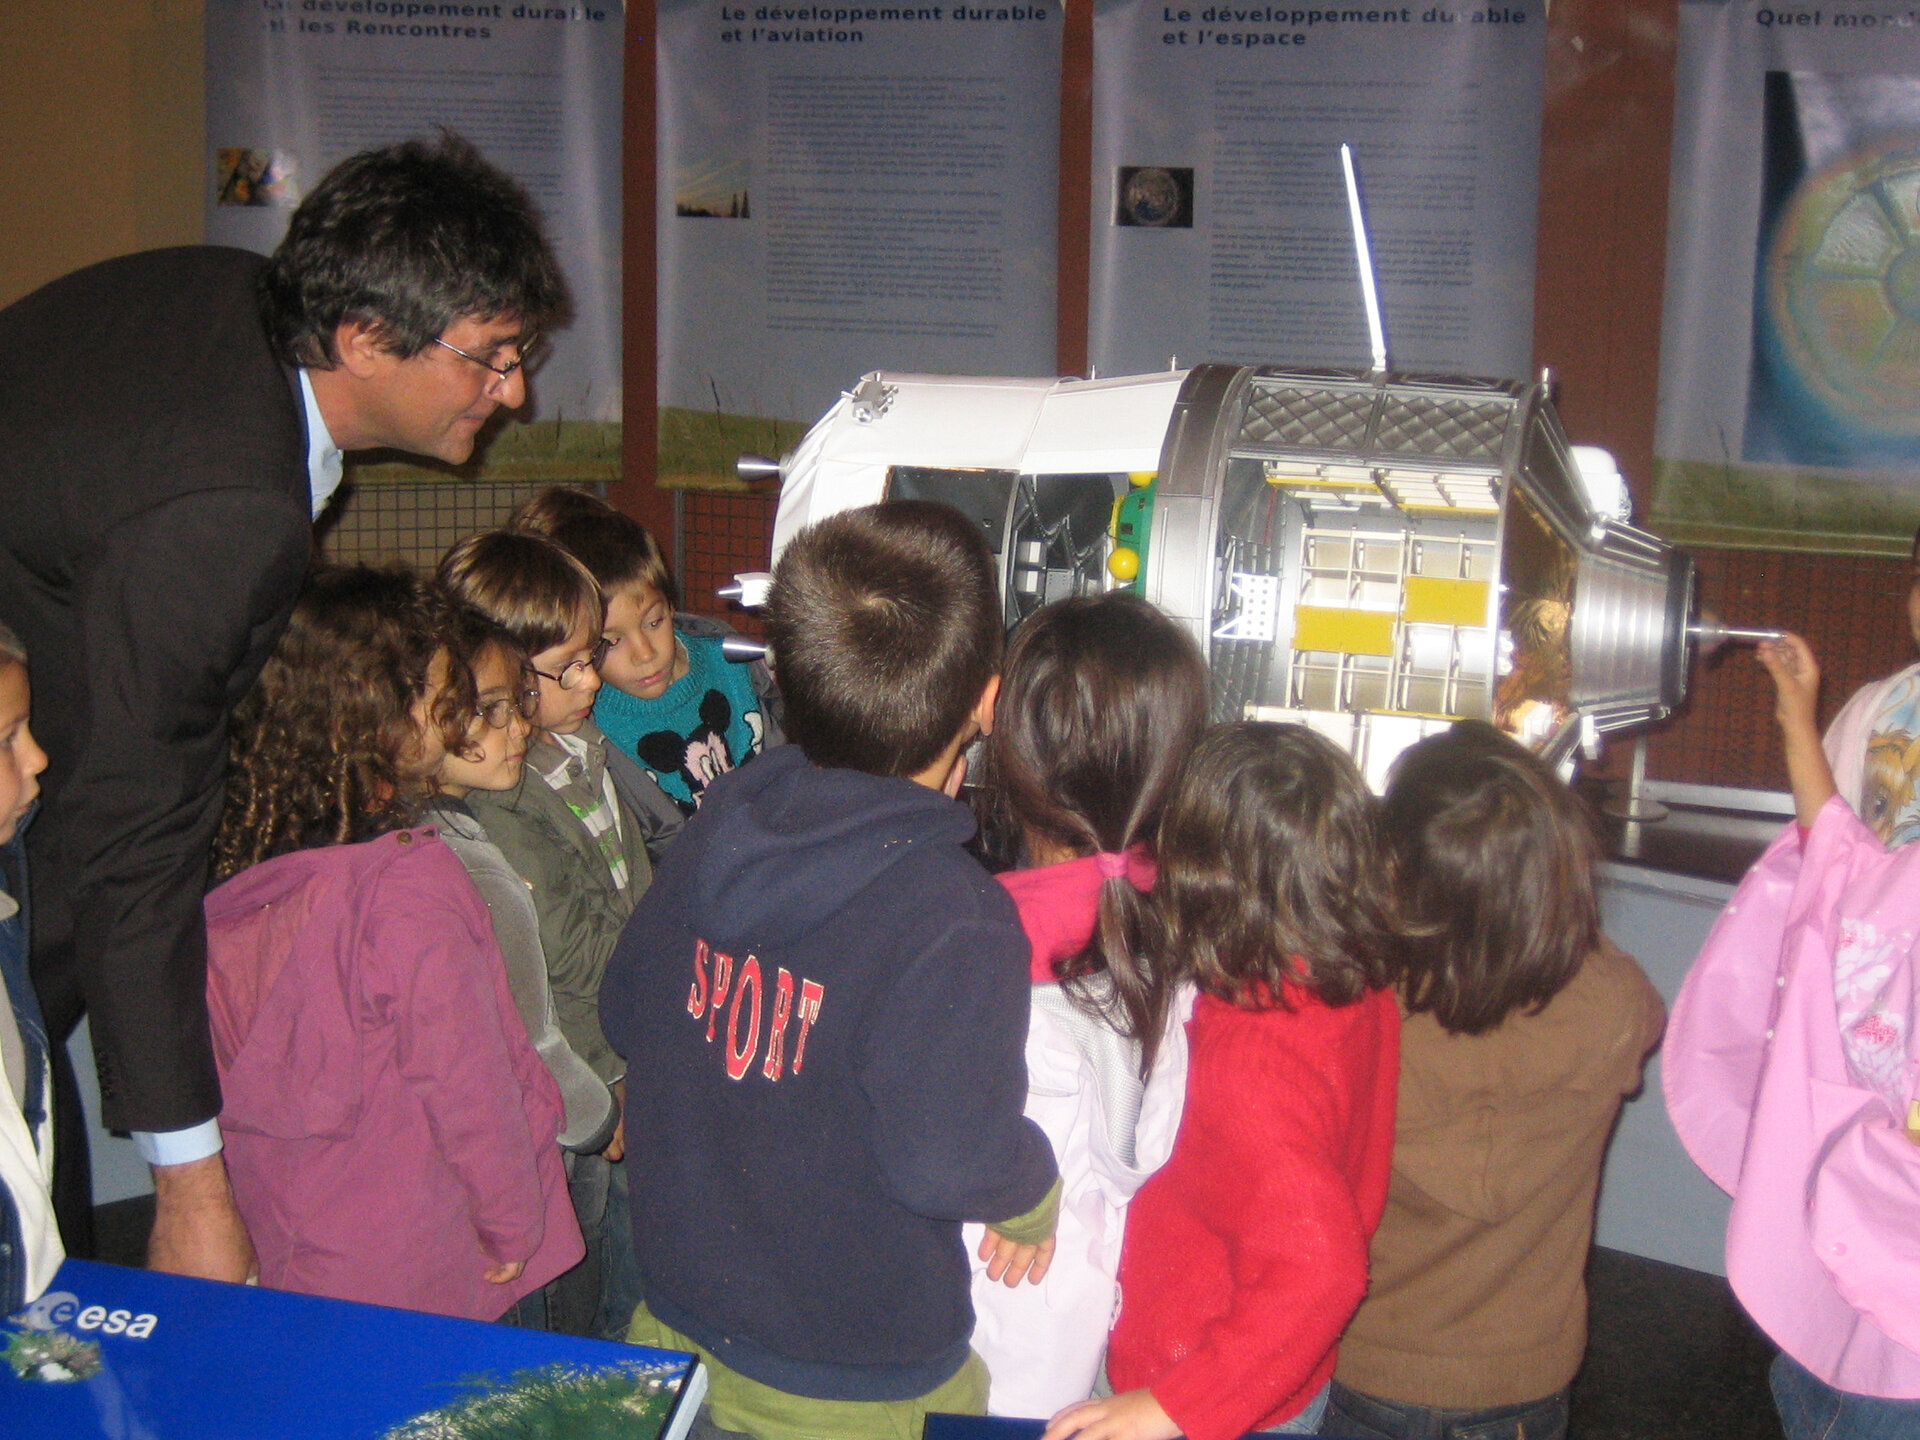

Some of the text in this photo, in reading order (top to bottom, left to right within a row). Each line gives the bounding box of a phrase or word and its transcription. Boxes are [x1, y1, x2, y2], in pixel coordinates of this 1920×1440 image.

[722, 5, 1047, 23] Le développement durable
[1164, 6, 1526, 25] Le développement duable
[1756, 9, 1820, 28] Quel
[300, 18, 335, 34] les
[347, 20, 492, 38] Rencontres
[721, 28, 863, 42] et l'aviation
[1163, 30, 1306, 47] et l'espace
[686, 939, 825, 1082] SPORT
[77, 1305, 159, 1339] esa
